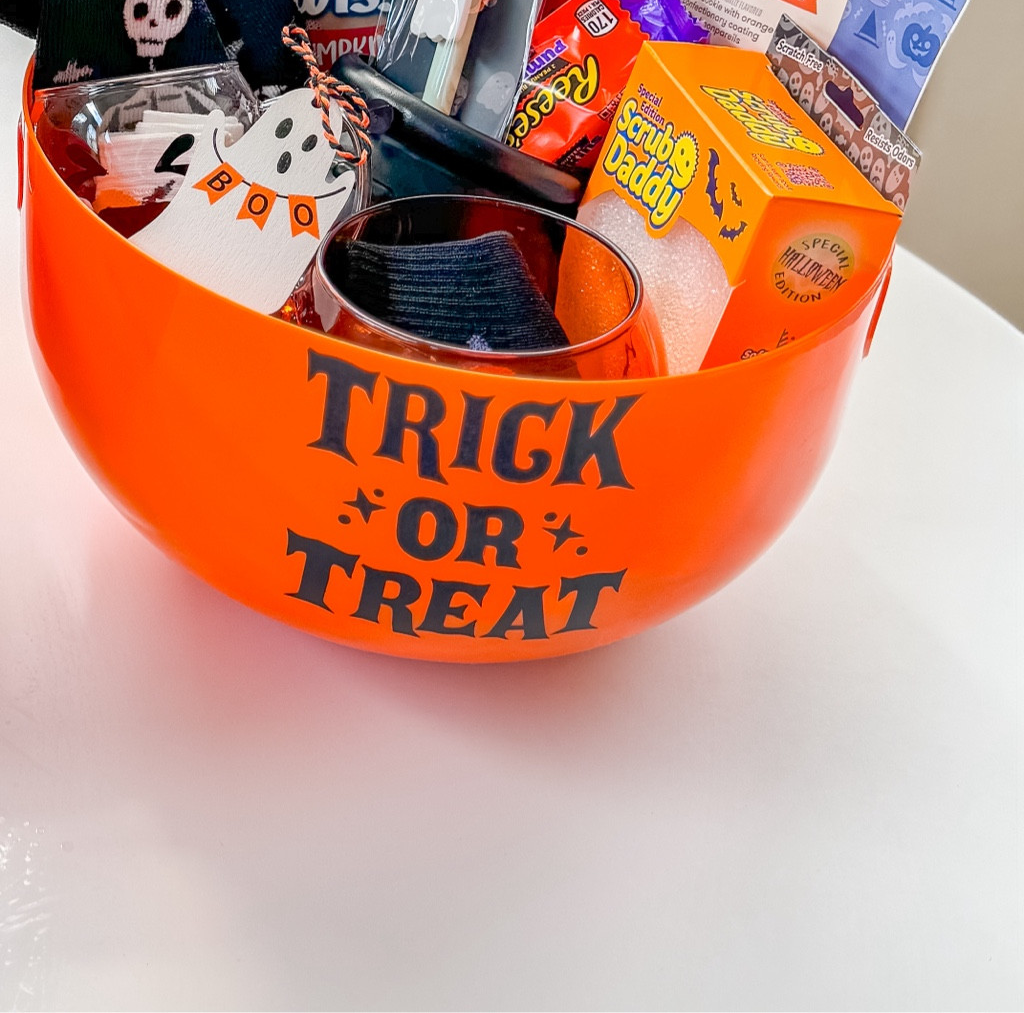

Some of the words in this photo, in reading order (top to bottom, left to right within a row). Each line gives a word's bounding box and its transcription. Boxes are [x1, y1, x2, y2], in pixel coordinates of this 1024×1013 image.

[581, 4, 605, 23] CALORIES
[588, 12, 613, 34] 170
[724, 5, 739, 19] with
[741, 16, 774, 34] orange
[728, 22, 760, 42] coating
[777, 39, 805, 65] Scratch
[805, 54, 823, 71] Free
[529, 66, 552, 85] PEANU
[508, 54, 600, 148] Reese's
[637, 83, 663, 107] Special
[640, 101, 665, 126] Edition
[617, 98, 675, 162] Scrub
[864, 129, 892, 153] Resists
[892, 146, 916, 168] Odors
[604, 133, 683, 228] Daddy
[207, 169, 313, 227] BOO
[778, 245, 848, 293] HALLOWEEN
[802, 238, 849, 270] SPECIAL
[774, 271, 822, 303] EDITION
[306, 348, 646, 491] TRICK
[396, 496, 525, 569] OR
[285, 528, 628, 640] TREAT
